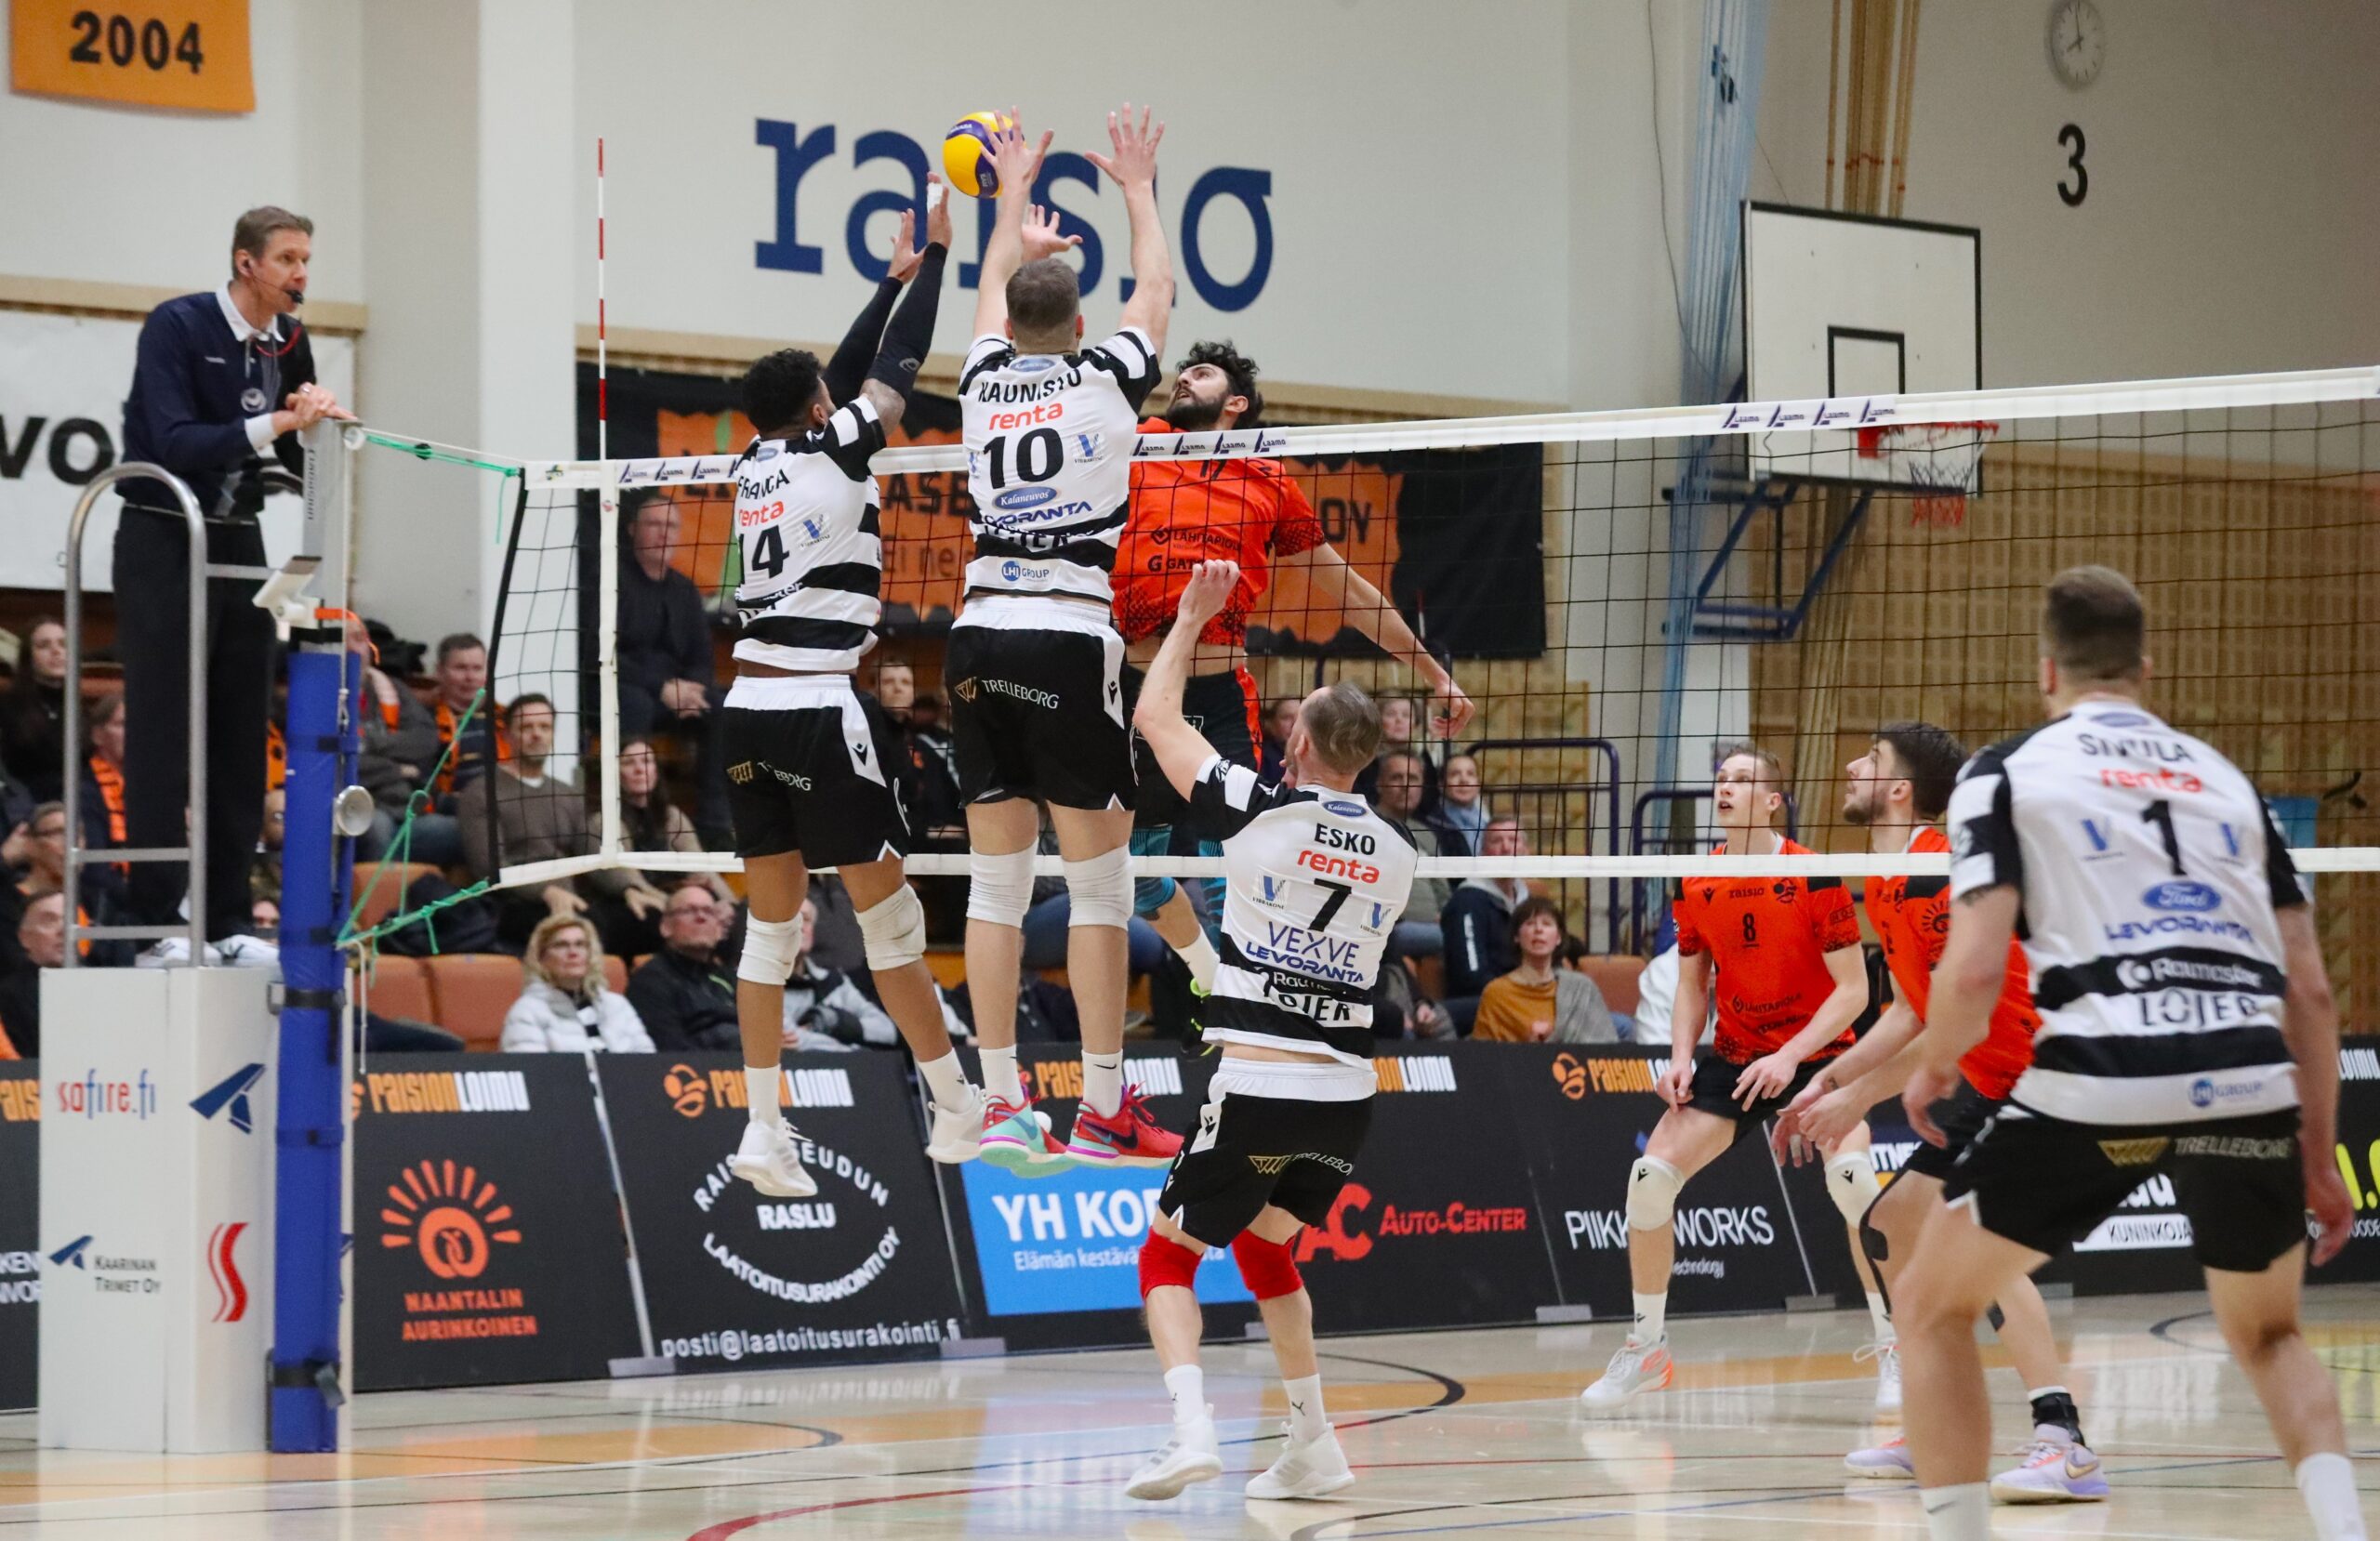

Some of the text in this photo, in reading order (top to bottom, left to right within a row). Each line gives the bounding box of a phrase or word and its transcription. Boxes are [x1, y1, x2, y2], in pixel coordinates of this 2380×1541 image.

[70, 10, 204, 72] 2004
[2056, 123, 2089, 206] 3
[754, 117, 1274, 313] raso
[989, 402, 1064, 430] renta
[983, 427, 1064, 489] 10
[1000, 490, 1051, 507] Kalaneuvos
[1319, 497, 1372, 544] OY
[982, 679, 1060, 710] TRELLEBORG
[2099, 767, 2202, 793] renta
[1314, 823, 1376, 856] ESKO
[2141, 798, 2188, 876] 1
[1297, 850, 1381, 884] renta
[1308, 878, 1353, 932] 7
[1268, 921, 1360, 968] VEXVE
[1742, 912, 1757, 942] 8
[1246, 941, 1365, 982] LEVORANTA
[58, 1069, 156, 1119] safire.fi
[757, 1203, 837, 1230] RASLU
[992, 1192, 1066, 1242] YH
[703, 1226, 901, 1303] LAATOITUSURAKOINTI OY
[1014, 1249, 1073, 1271] Elämän
[403, 1288, 523, 1313] NAANTALIN
[402, 1315, 538, 1342] AURINKOINEN
[661, 1318, 962, 1362] posti@laatoitusurakointi.fi
